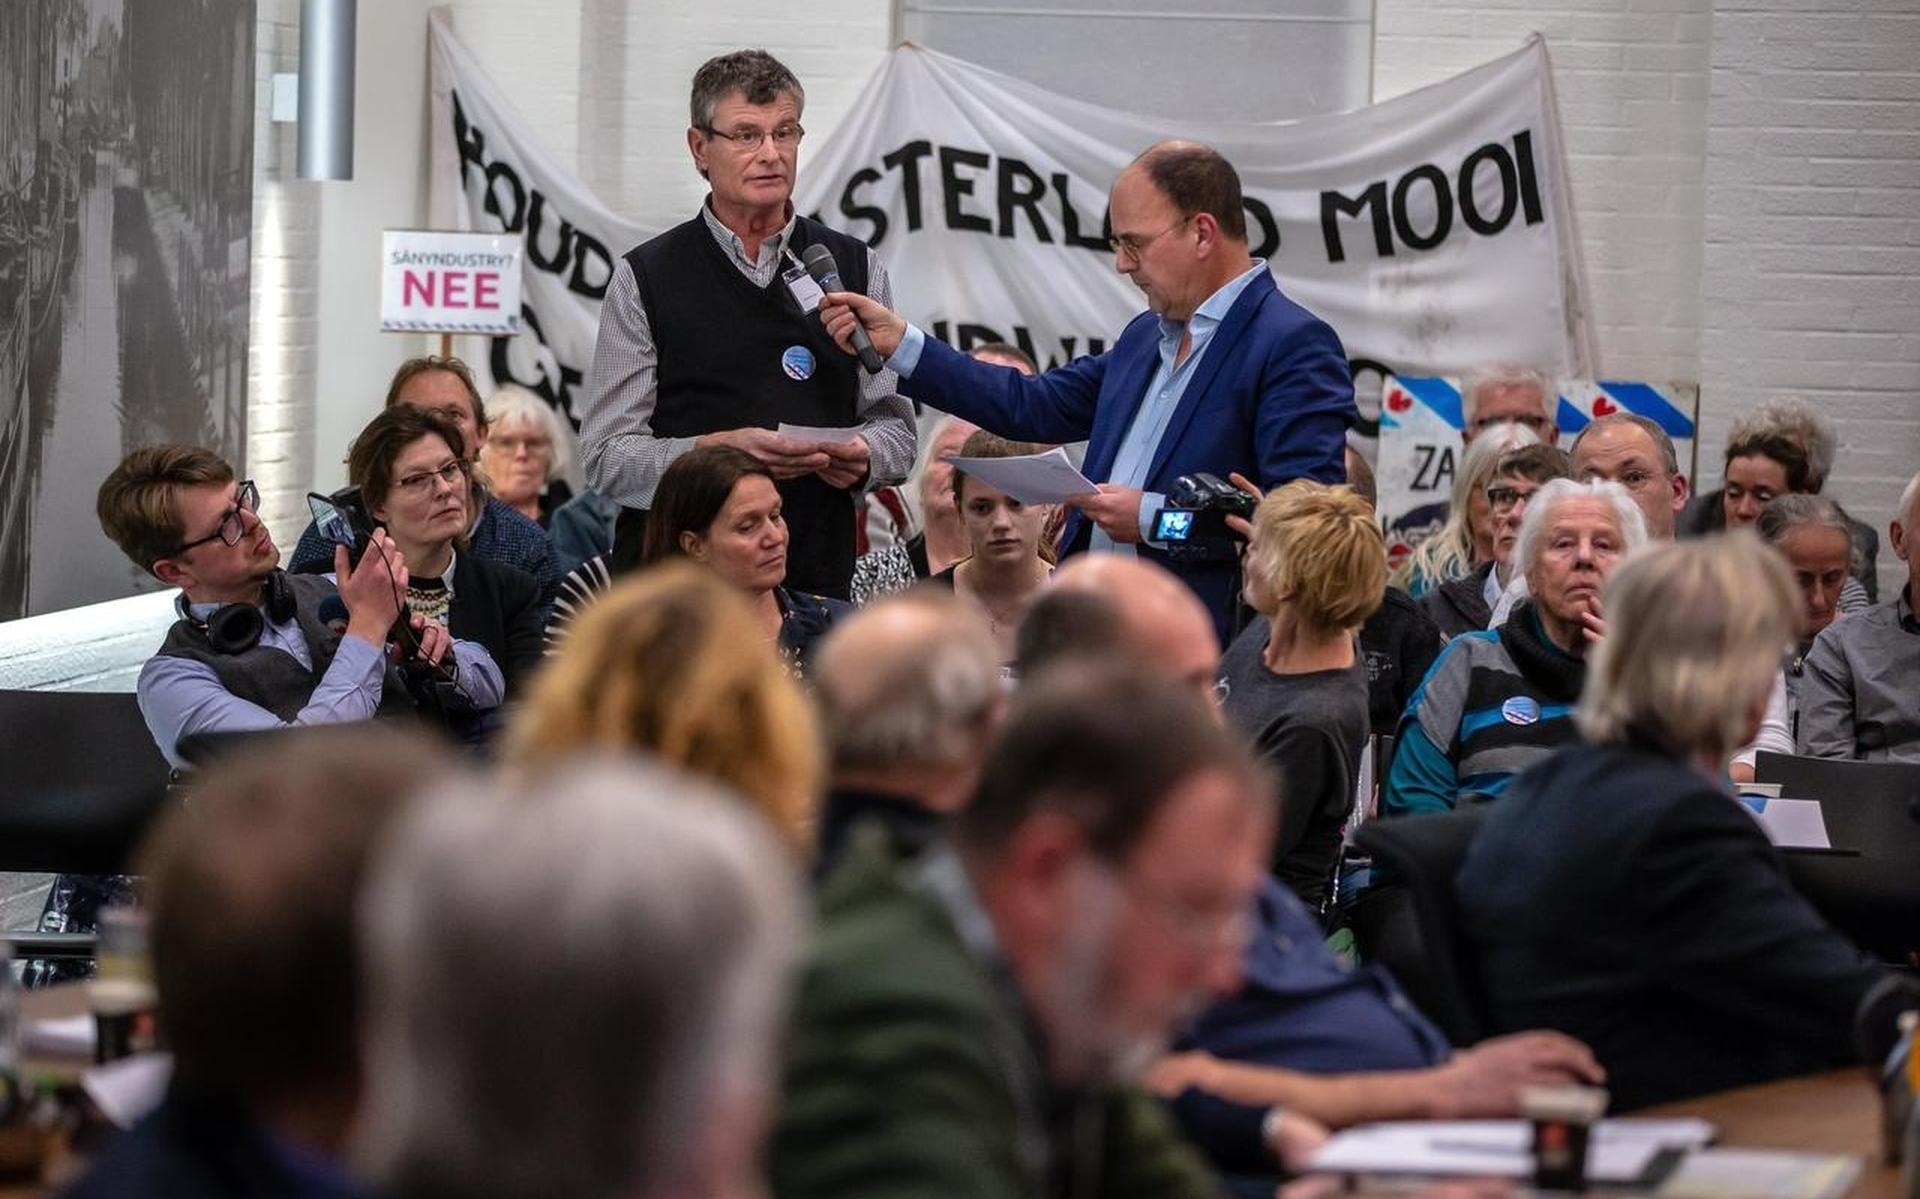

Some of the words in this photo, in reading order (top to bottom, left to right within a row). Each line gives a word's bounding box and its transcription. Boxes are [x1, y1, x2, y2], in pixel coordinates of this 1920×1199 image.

[1319, 129, 1545, 263] MOOI
[402, 269, 501, 310] NEE
[1408, 444, 1456, 491] ZA
